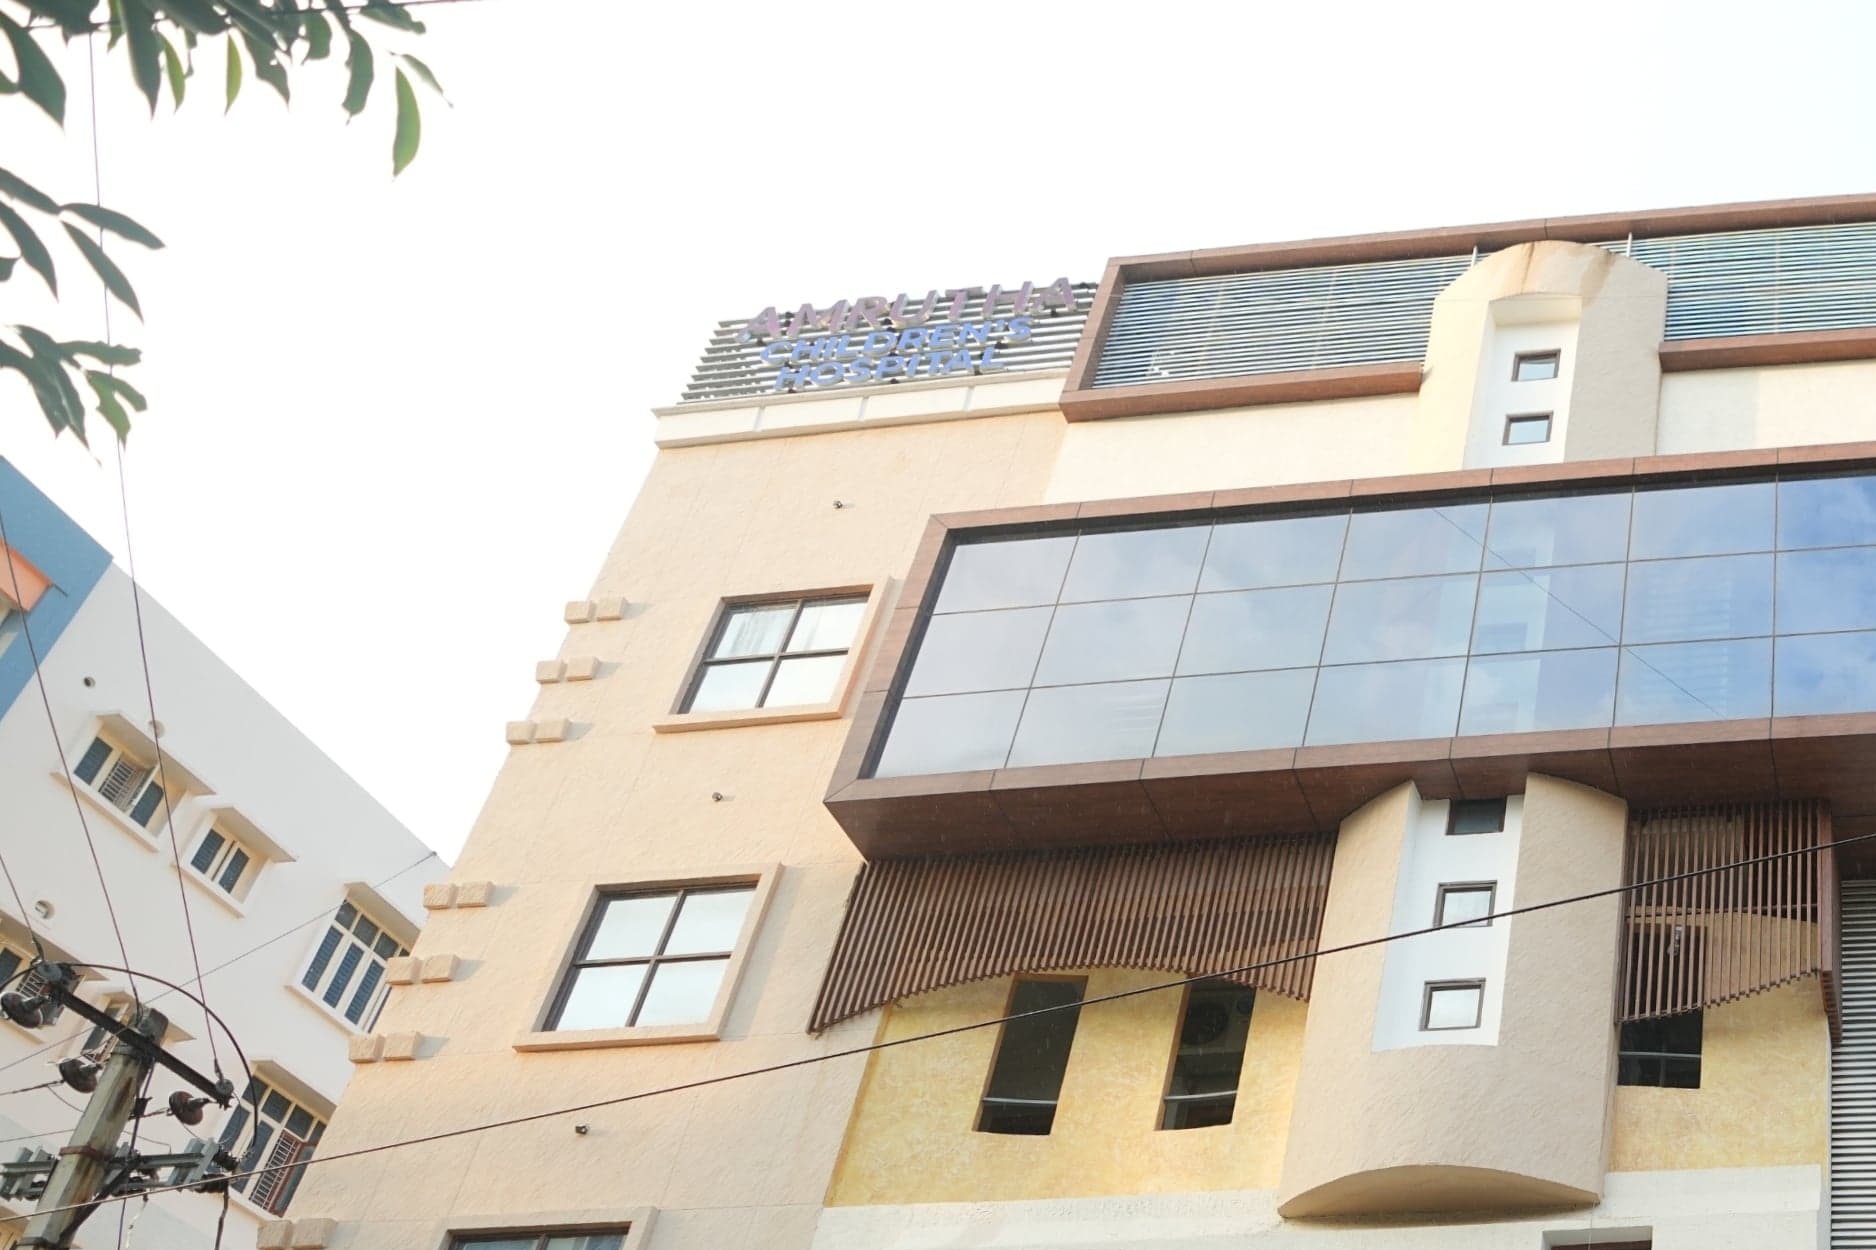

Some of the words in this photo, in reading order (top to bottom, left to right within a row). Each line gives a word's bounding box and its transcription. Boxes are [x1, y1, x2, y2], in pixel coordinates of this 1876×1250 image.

[737, 276, 1078, 343] AMRUTHA
[760, 316, 1034, 365] CHILDREN'S
[774, 345, 1005, 392] HOSPITAL
